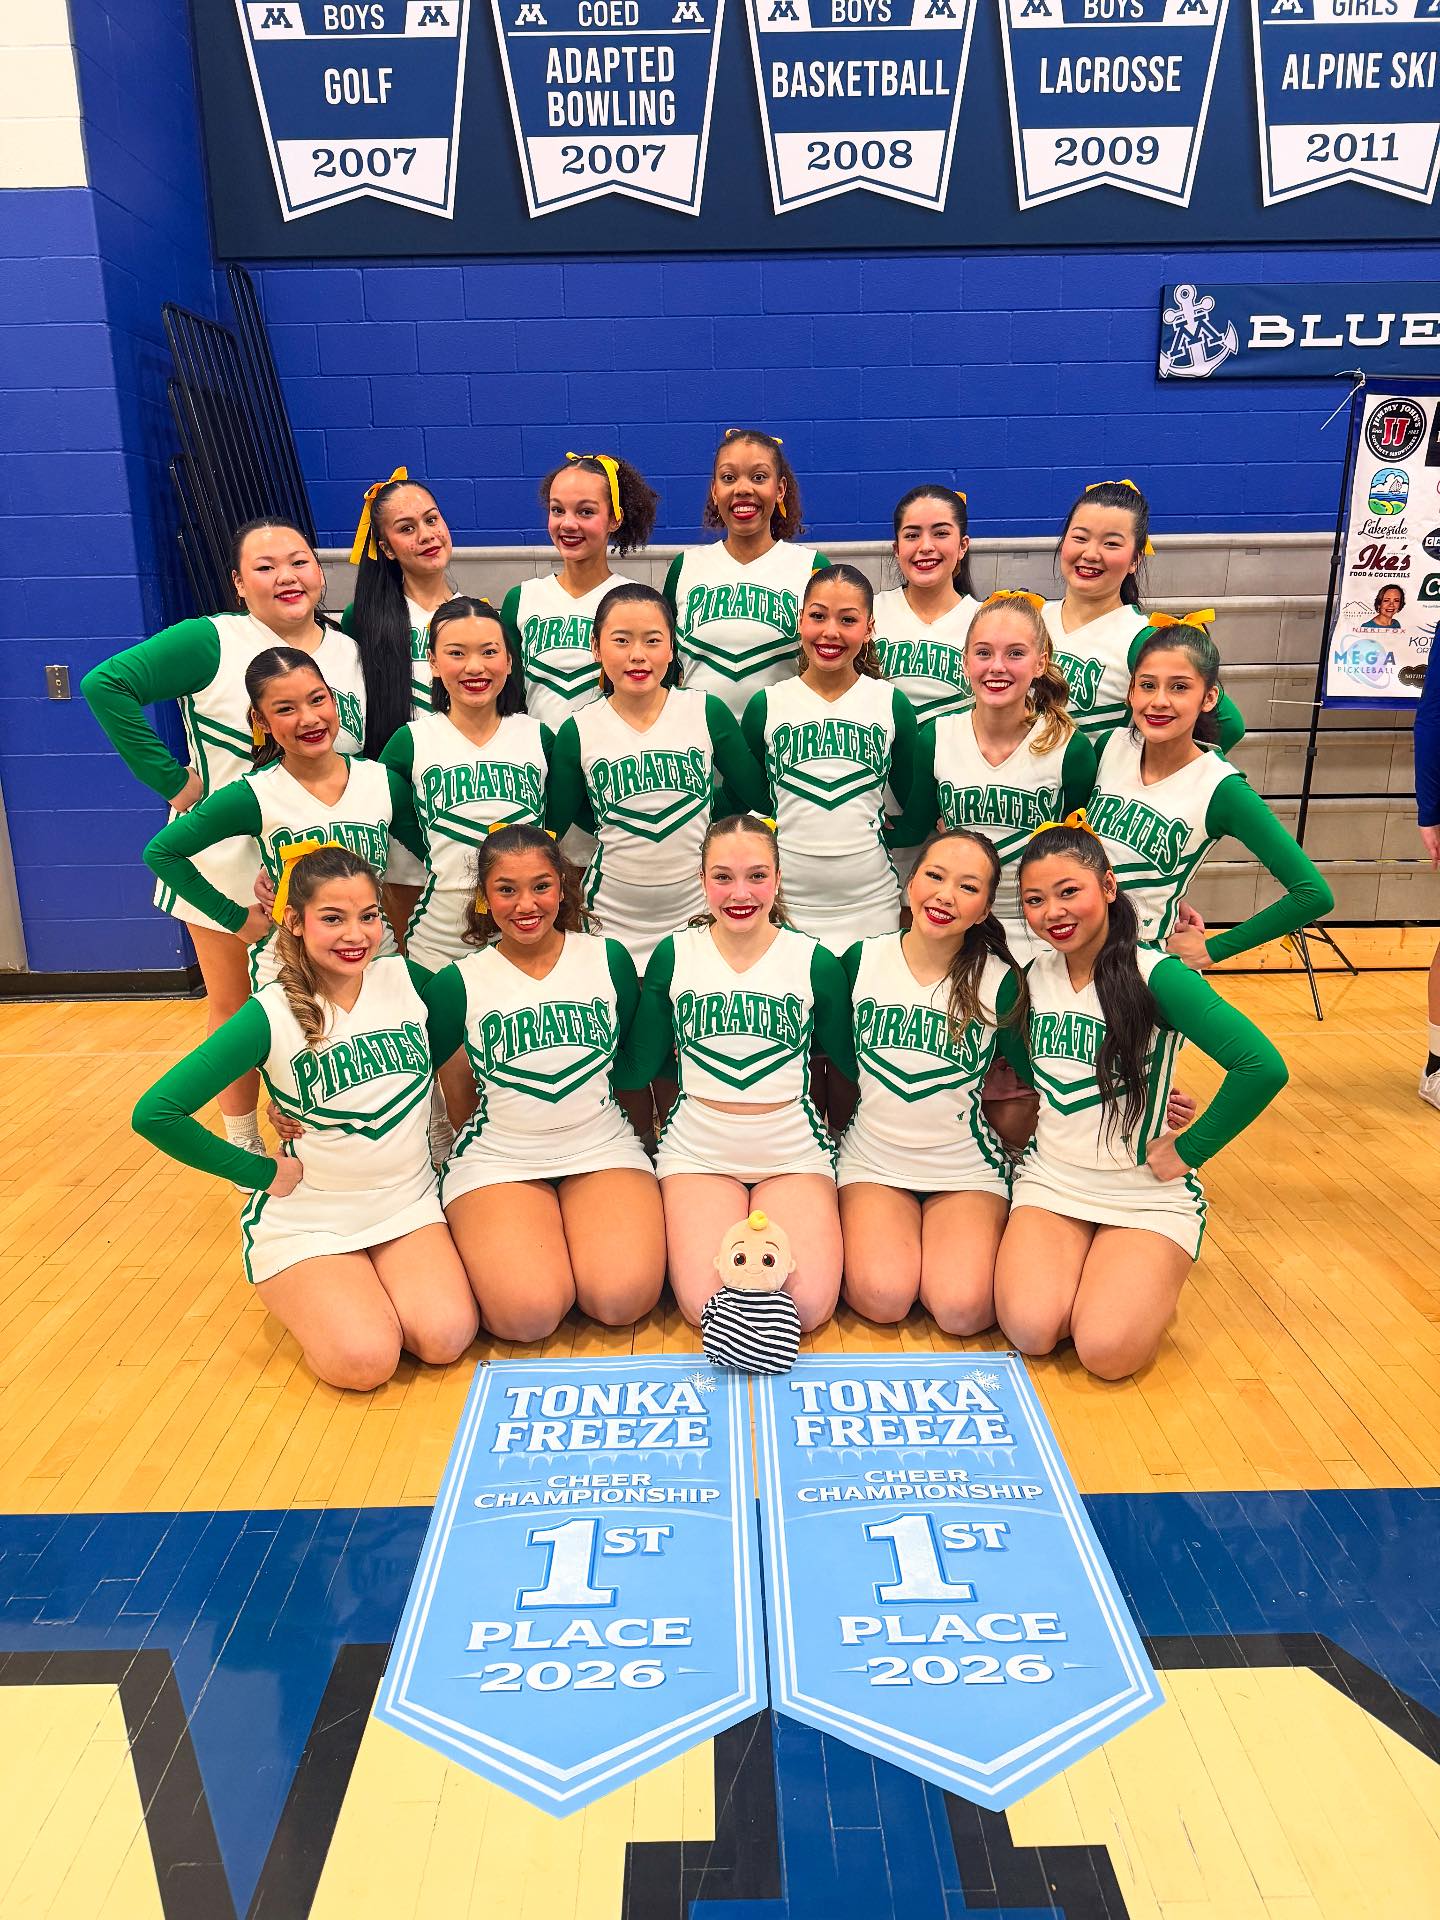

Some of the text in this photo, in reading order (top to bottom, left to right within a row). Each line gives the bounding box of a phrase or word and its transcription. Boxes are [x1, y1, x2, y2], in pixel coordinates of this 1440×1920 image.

[323, 4, 385, 30] BOYS
[578, 0, 639, 27] COED
[831, 0, 892, 23] BOYS
[1084, 0, 1144, 19] BOYS
[1332, 0, 1399, 16] GIRLS
[546, 46, 675, 84] ADAPTED
[771, 59, 950, 98] BASKETBALL
[1039, 55, 1183, 94] LACROSSE
[1282, 52, 1383, 90] ALPINE
[324, 67, 393, 105] GOLF
[547, 89, 676, 128] BOWLING
[312, 147, 417, 178] 2007
[561, 144, 666, 175] 2007
[807, 139, 913, 171] 2008
[1054, 135, 1160, 166] 2009
[1305, 131, 1399, 163] 2011
[1248, 313, 1440, 348] BLUE
[1373, 404, 1399, 427] JIMMY
[1381, 416, 1410, 446] JJ
[1358, 518, 1408, 539] Lakeside
[1352, 544, 1411, 570] Ike's
[684, 583, 799, 640] PIRATES
[523, 615, 597, 671] PIRAT
[1334, 650, 1396, 665] MEGA
[1337, 666, 1393, 674] PICKLEBALL
[772, 719, 888, 783] PIRATES
[421, 761, 544, 829] PIRATES
[589, 747, 715, 820] PIRATES
[478, 996, 613, 1075] PIRATES
[676, 990, 803, 1050] PIRATES
[855, 998, 986, 1074] PIRATES
[289, 1020, 432, 1116] PIRATES
[505, 1381, 710, 1420] TONKA
[790, 1378, 1003, 1414] TONKA
[489, 1416, 713, 1454] FREEZE
[791, 1414, 1017, 1448] FREEZE
[546, 1473, 653, 1488] CHEER
[863, 1469, 970, 1483] CHEER
[474, 1488, 721, 1509] CHAMPIONSHIP
[796, 1484, 1044, 1503] CHAMPIONSHIP
[464, 1617, 694, 1653] PLACE
[838, 1612, 1068, 1646] PLACE
[479, 1659, 666, 1692] 2026
[866, 1654, 1055, 1687] 2026
